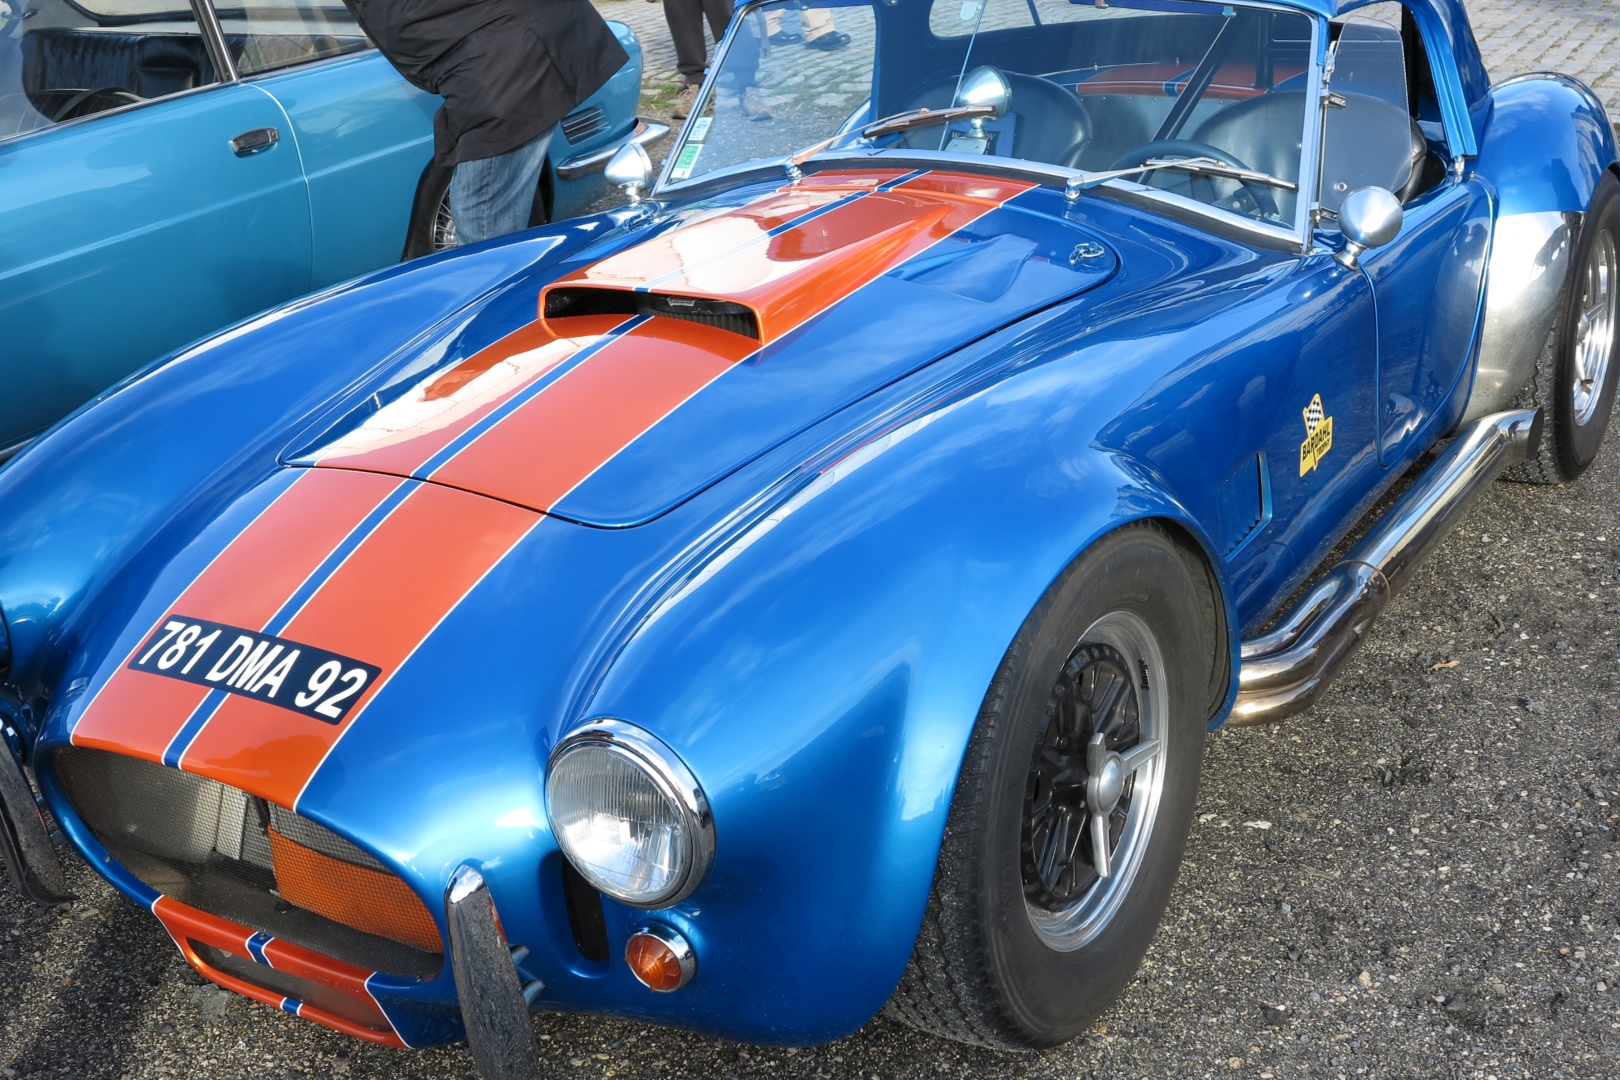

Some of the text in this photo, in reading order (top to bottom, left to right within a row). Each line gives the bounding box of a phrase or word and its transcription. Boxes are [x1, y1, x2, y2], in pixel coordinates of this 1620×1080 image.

[1302, 421, 1330, 461] BARDAHL
[138, 620, 368, 719] 781 DMA 92
